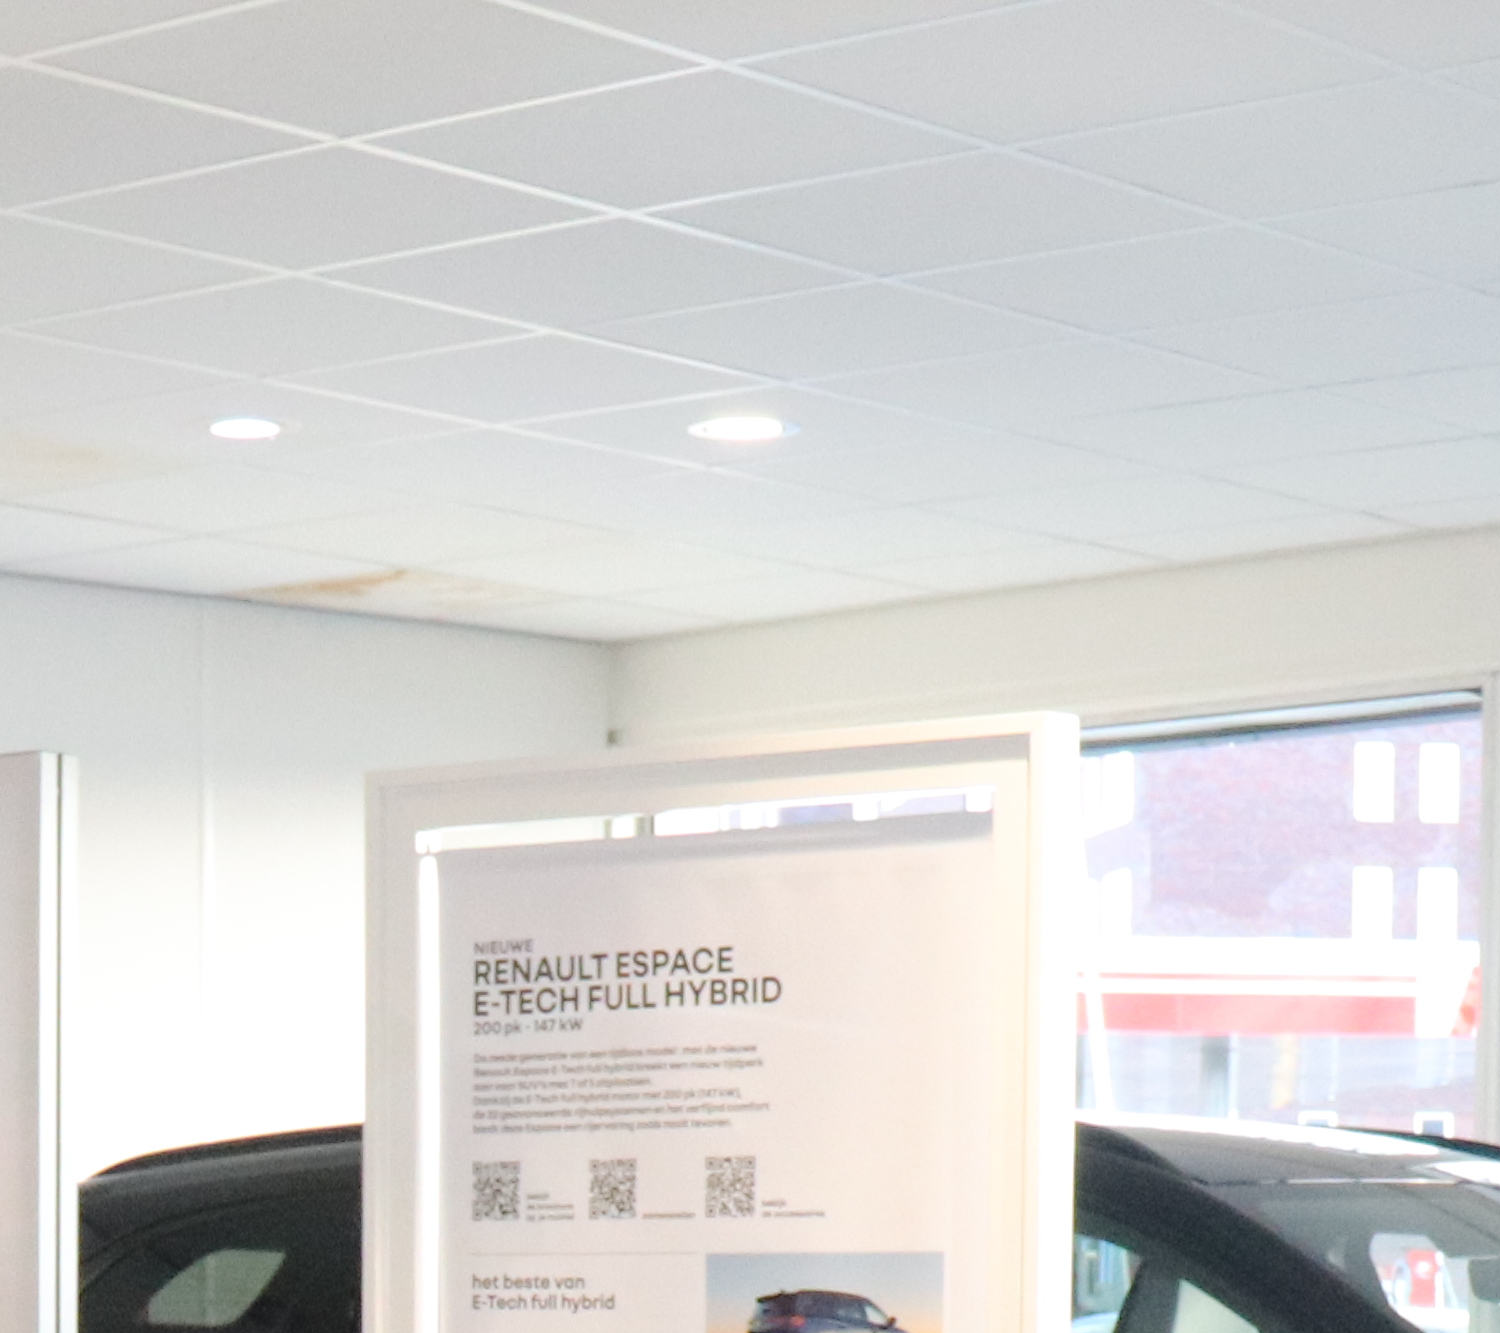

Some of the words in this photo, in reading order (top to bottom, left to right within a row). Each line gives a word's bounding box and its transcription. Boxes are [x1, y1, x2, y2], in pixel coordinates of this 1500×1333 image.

[474, 938, 534, 954] NIEUWE
[474, 953, 608, 985] RENAULT
[616, 946, 734, 978] ESPACE
[474, 986, 579, 1017] E-TECH
[588, 982, 656, 1011] FULL
[665, 975, 782, 1007] HYBRID
[474, 1021, 500, 1035] 200
[504, 1021, 521, 1036] pk
[533, 1019, 556, 1033] 147
[559, 1018, 583, 1032] kW
[471, 1274, 499, 1290] het
[503, 1273, 550, 1290] beste
[554, 1276, 586, 1290] van
[471, 1294, 527, 1310] E-Tech
[530, 1294, 558, 1310] full
[560, 1294, 616, 1314] hybrid
